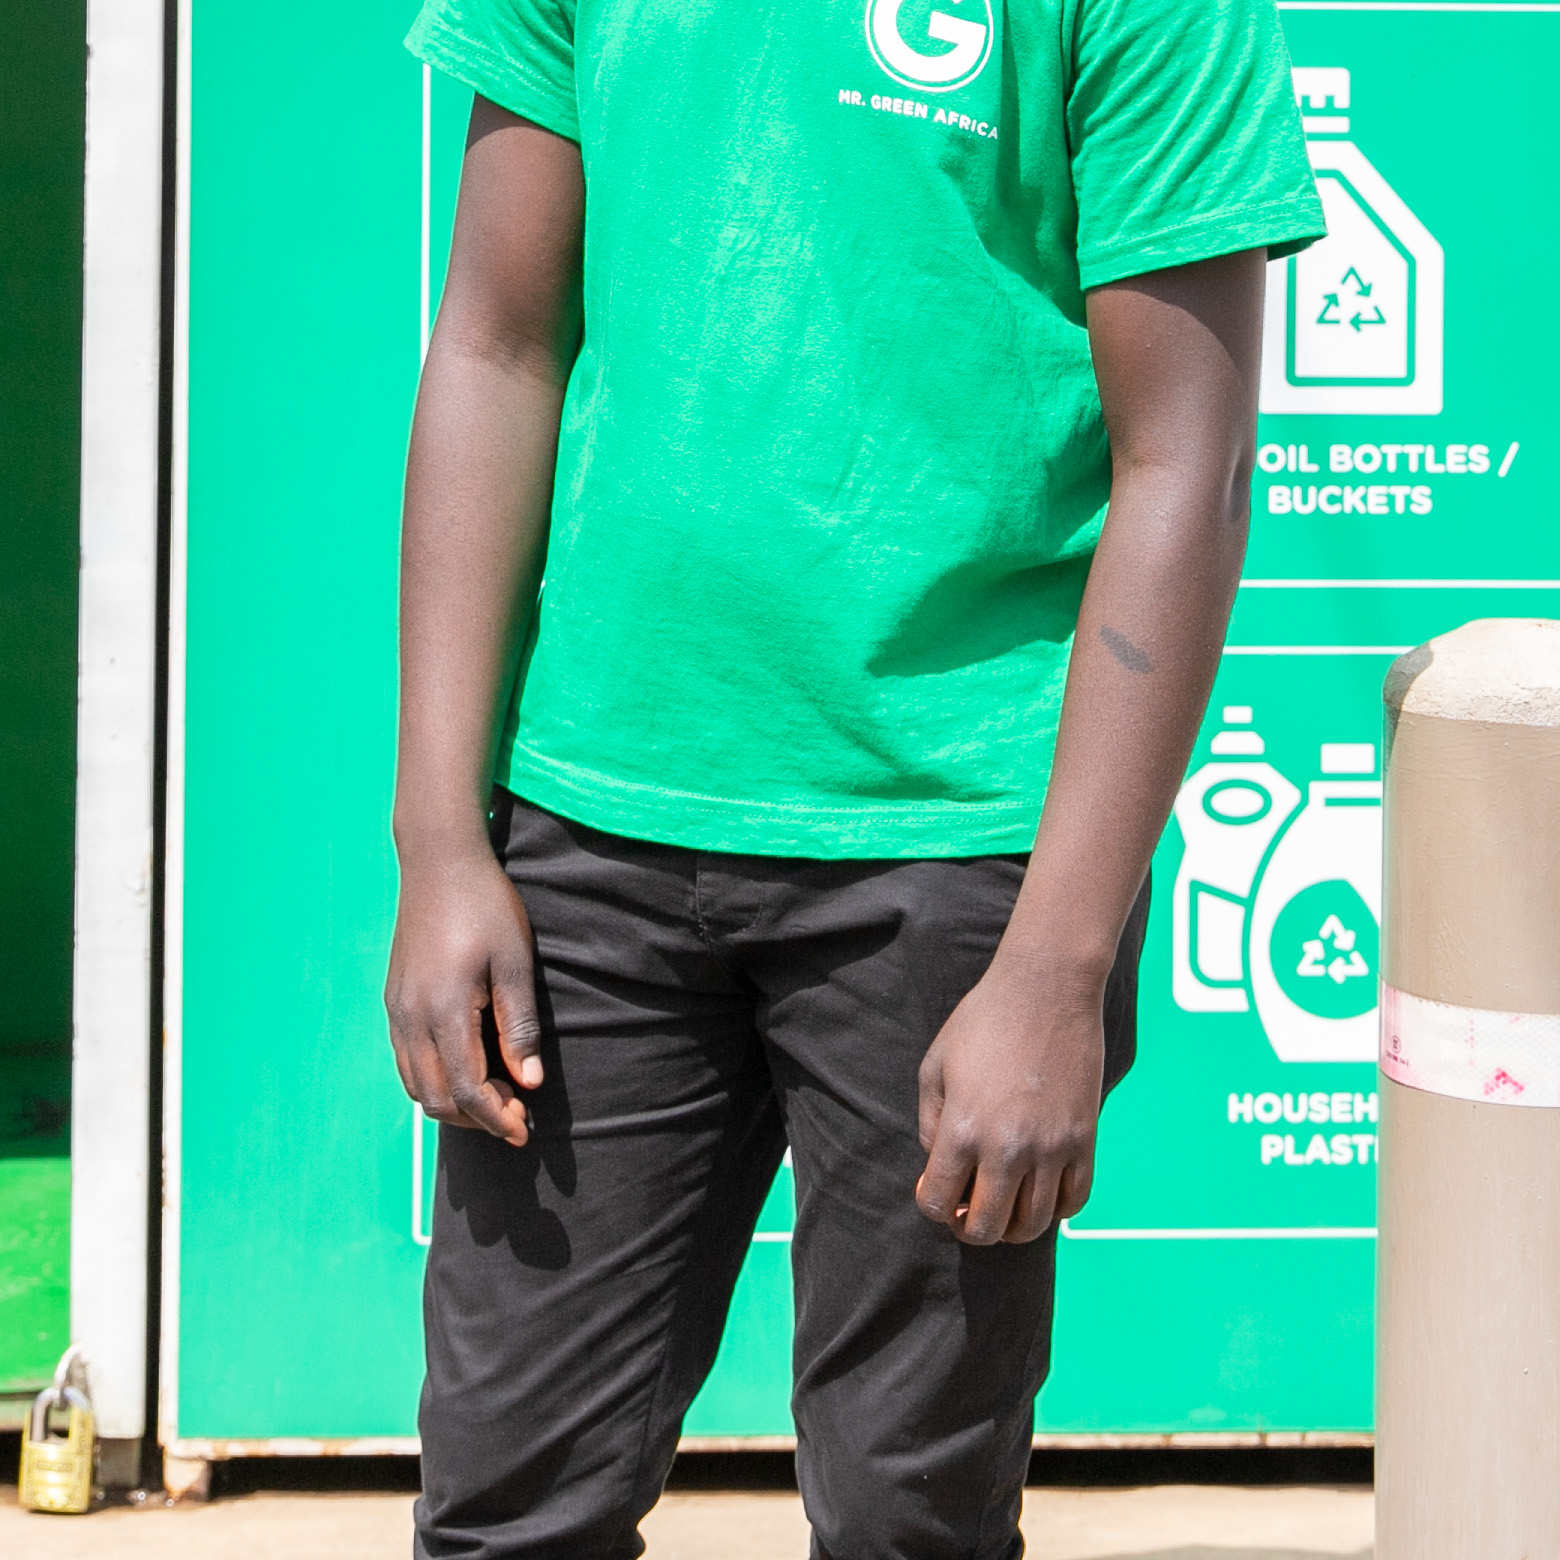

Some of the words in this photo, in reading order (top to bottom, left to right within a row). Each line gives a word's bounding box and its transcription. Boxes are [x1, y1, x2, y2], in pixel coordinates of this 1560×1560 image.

[838, 89, 866, 108] MR.
[870, 94, 928, 119] GREEN
[933, 108, 998, 140] AFRICA
[1258, 444, 1320, 473] OIL
[1330, 444, 1491, 473] BOTTLES
[1497, 441, 1520, 478] /
[1268, 485, 1433, 515] BUCKETS
[1227, 1092, 1379, 1124] HOUSEH
